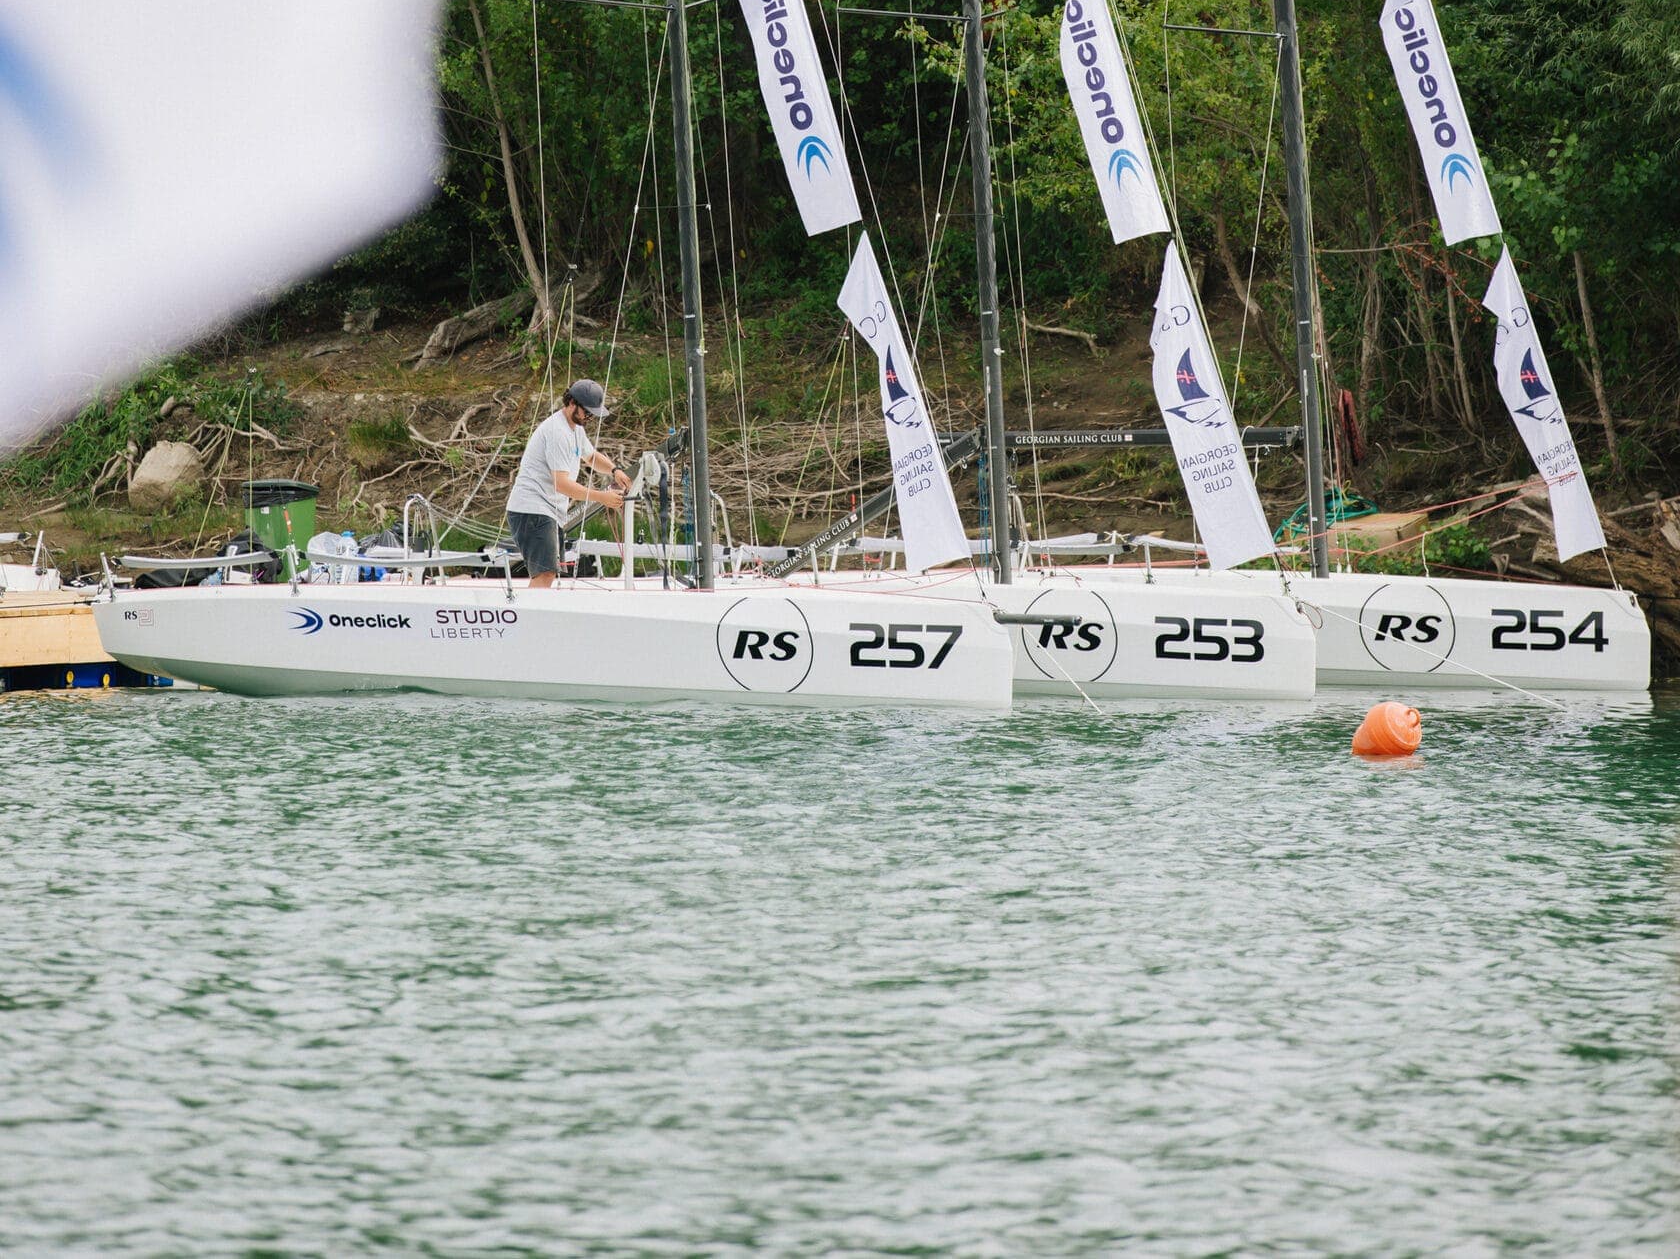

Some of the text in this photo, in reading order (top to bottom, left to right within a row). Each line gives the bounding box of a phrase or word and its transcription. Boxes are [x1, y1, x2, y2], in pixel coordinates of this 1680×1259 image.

[1015, 433, 1122, 444] GEORGIAN SAILING CLUB
[831, 518, 850, 536] CLUB
[436, 609, 518, 624] STUDIO
[1374, 614, 1443, 643] RS
[1491, 608, 1609, 653] 254
[430, 628, 506, 639] LIBERTY
[732, 629, 800, 661] RS
[849, 623, 963, 669] 257
[1037, 622, 1104, 651] RS
[1154, 616, 1265, 663] 253
